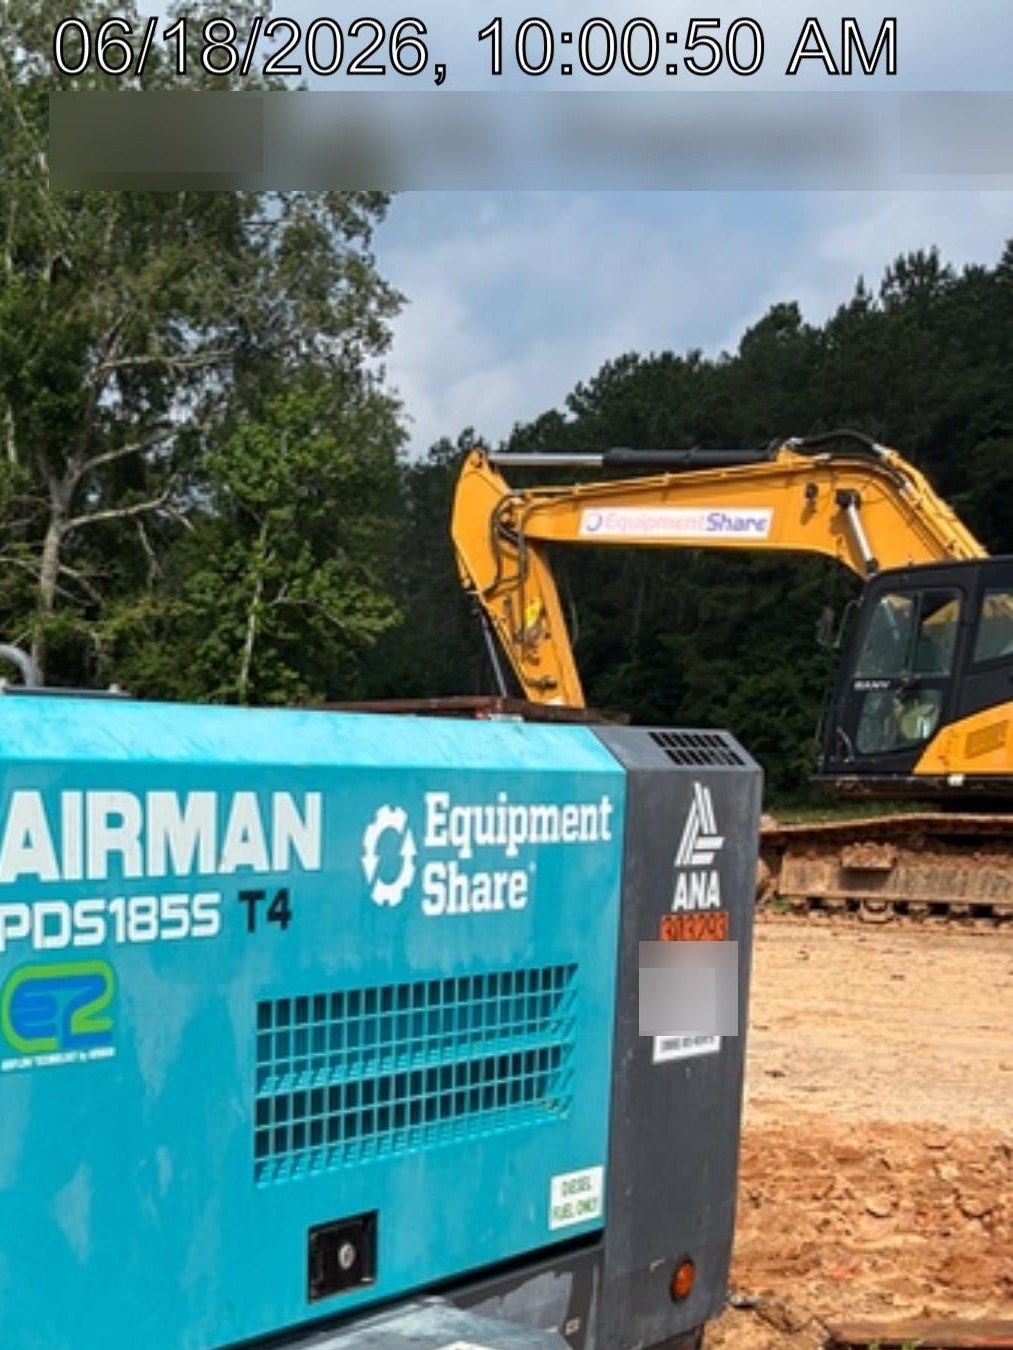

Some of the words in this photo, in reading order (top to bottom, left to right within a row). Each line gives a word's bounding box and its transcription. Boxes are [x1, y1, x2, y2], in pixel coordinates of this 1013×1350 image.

[424, 790, 613, 859] Equipment
[239, 888, 292, 932] T4
[421, 860, 529, 917] Share
[671, 870, 721, 912] ANA
